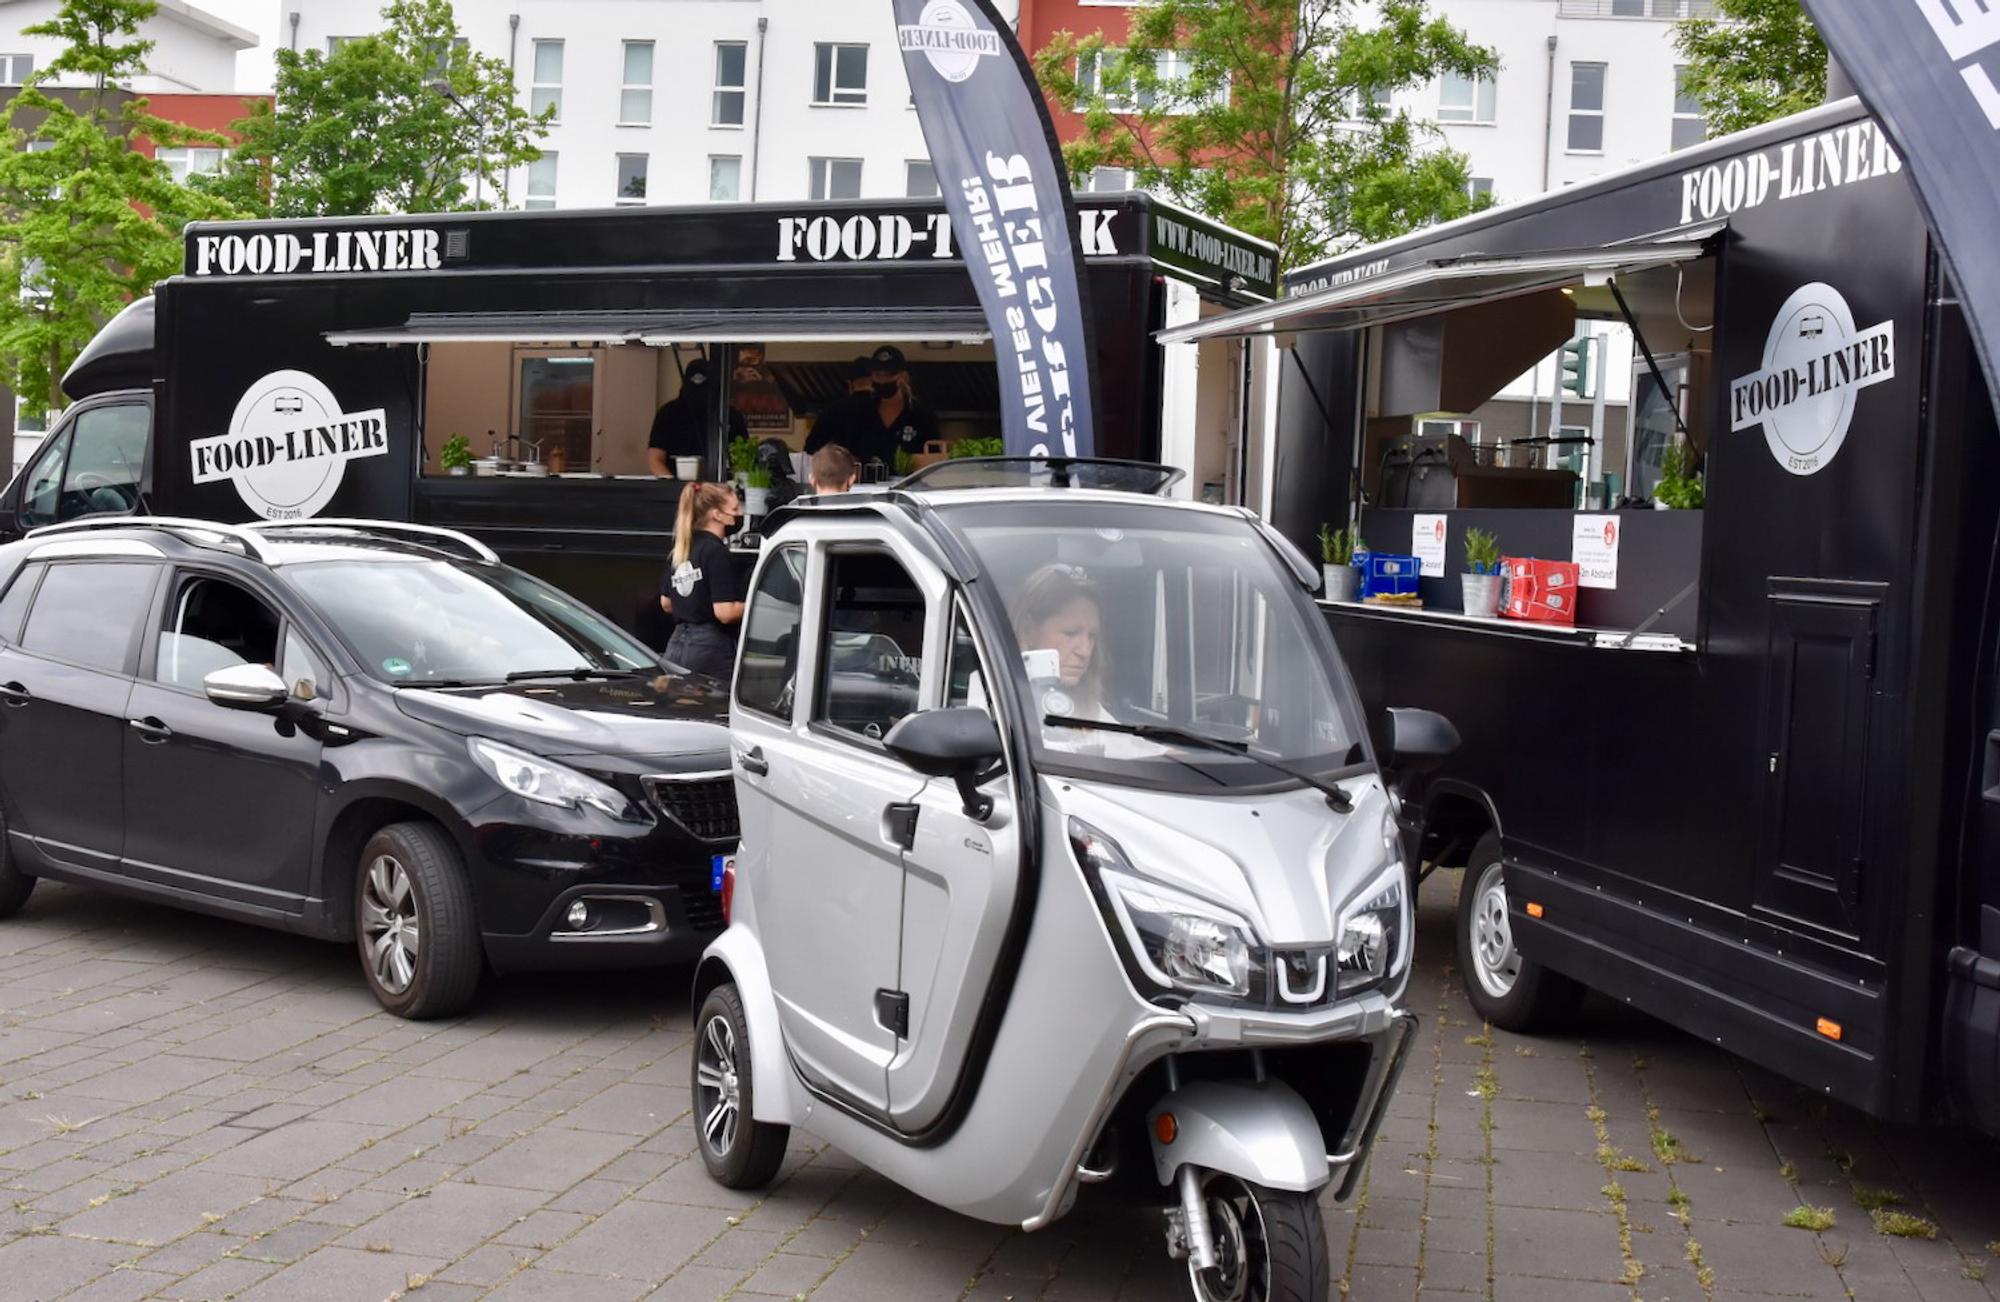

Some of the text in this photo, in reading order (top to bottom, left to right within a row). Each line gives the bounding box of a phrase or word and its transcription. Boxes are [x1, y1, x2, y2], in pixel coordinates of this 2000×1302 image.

[1680, 119, 1902, 224] FOOD-LINER
[195, 228, 441, 275] FOOD-LINER
[1156, 215, 1272, 284] WWW.FOOD-LINER.DE
[1734, 334, 1892, 422] FOOD-LINER
[195, 417, 385, 476] FOOD-LINER
